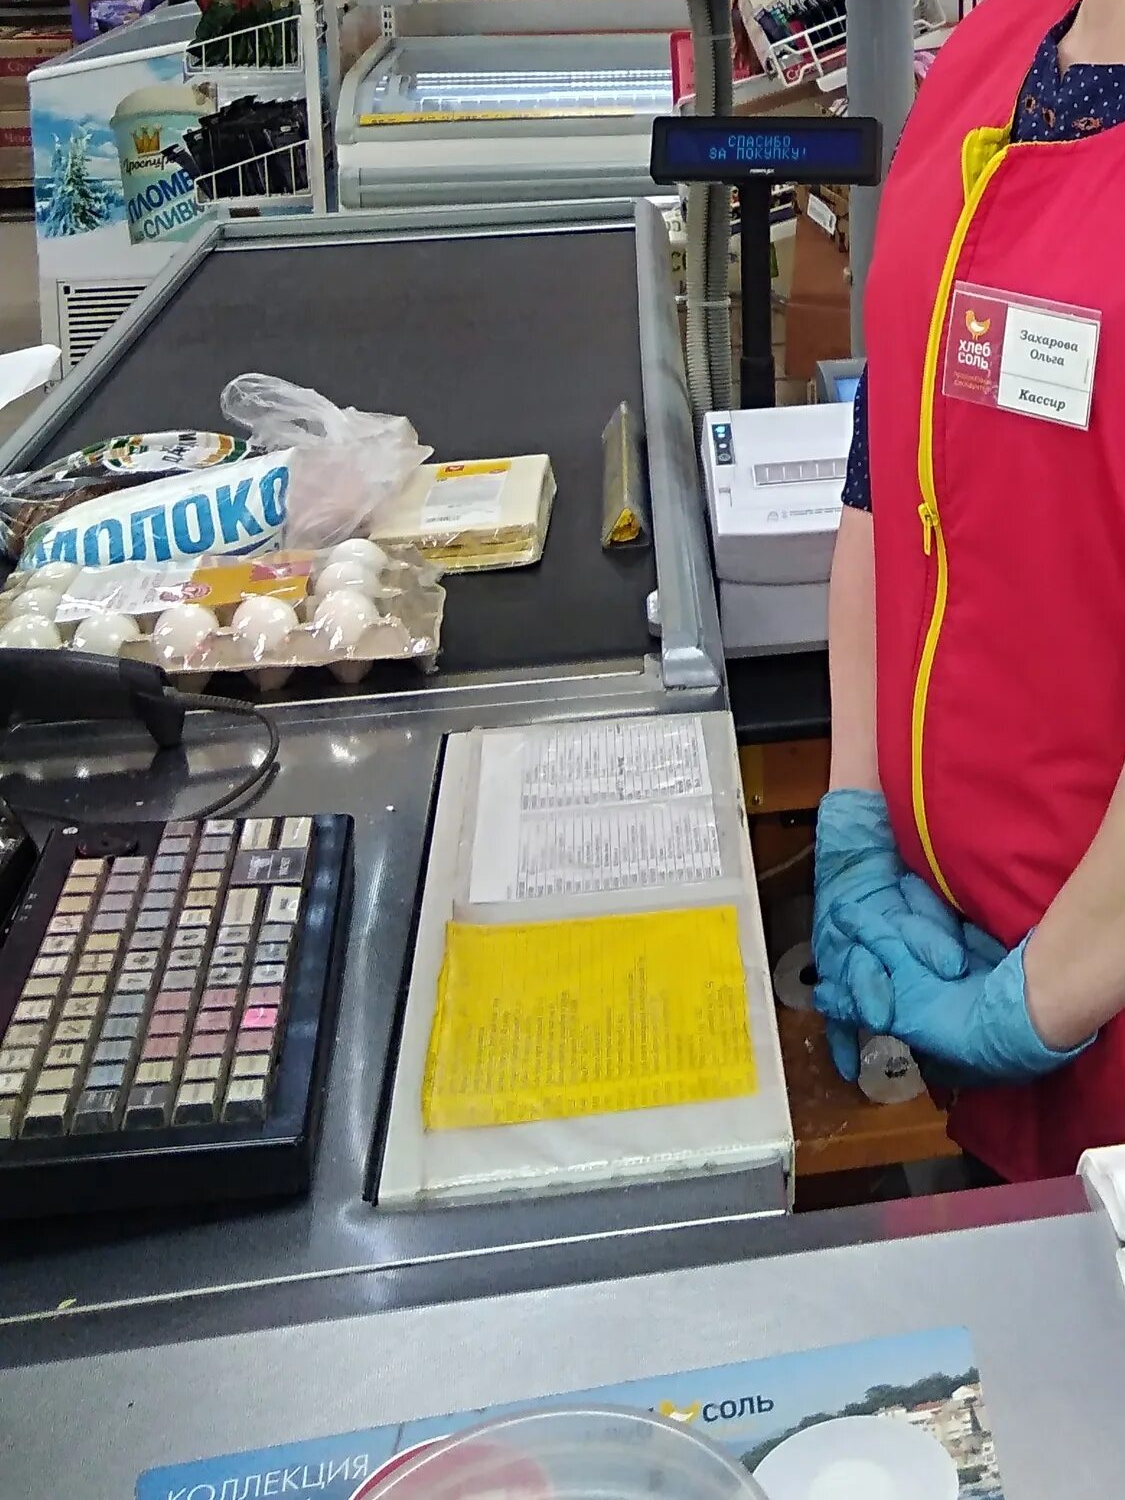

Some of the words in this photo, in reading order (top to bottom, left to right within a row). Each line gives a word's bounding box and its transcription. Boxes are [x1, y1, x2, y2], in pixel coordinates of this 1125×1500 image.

[728, 134, 791, 147] СПАСИБО
[709, 150, 727, 160] ЗА
[736, 147, 807, 161] ПОКУПКУ!
[958, 339, 991, 358] хлеб
[1020, 329, 1079, 353] Захарова
[957, 351, 990, 371] соль
[1030, 349, 1065, 366] Ольга
[1018, 389, 1066, 412] Кассир
[166, 1453, 370, 1500] КОЛЛЕКЦИЯ
